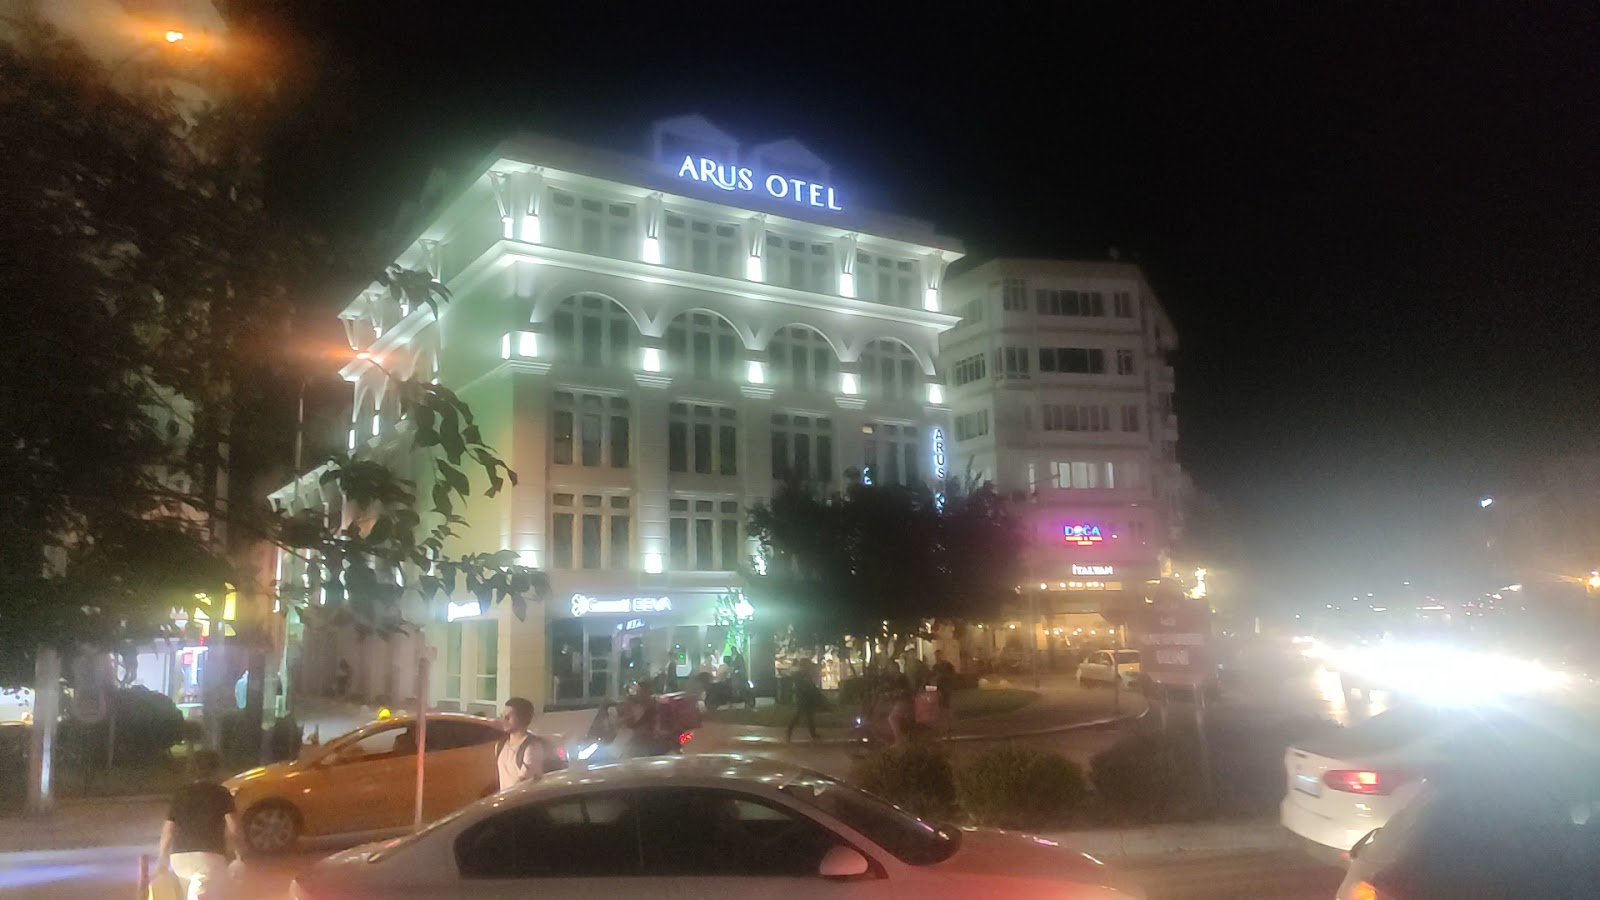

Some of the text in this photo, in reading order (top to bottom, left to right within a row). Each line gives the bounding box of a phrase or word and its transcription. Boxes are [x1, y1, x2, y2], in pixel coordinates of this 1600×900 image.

[678, 155, 842, 211] ARUS OTEL
[934, 428, 945, 479] ARUS
